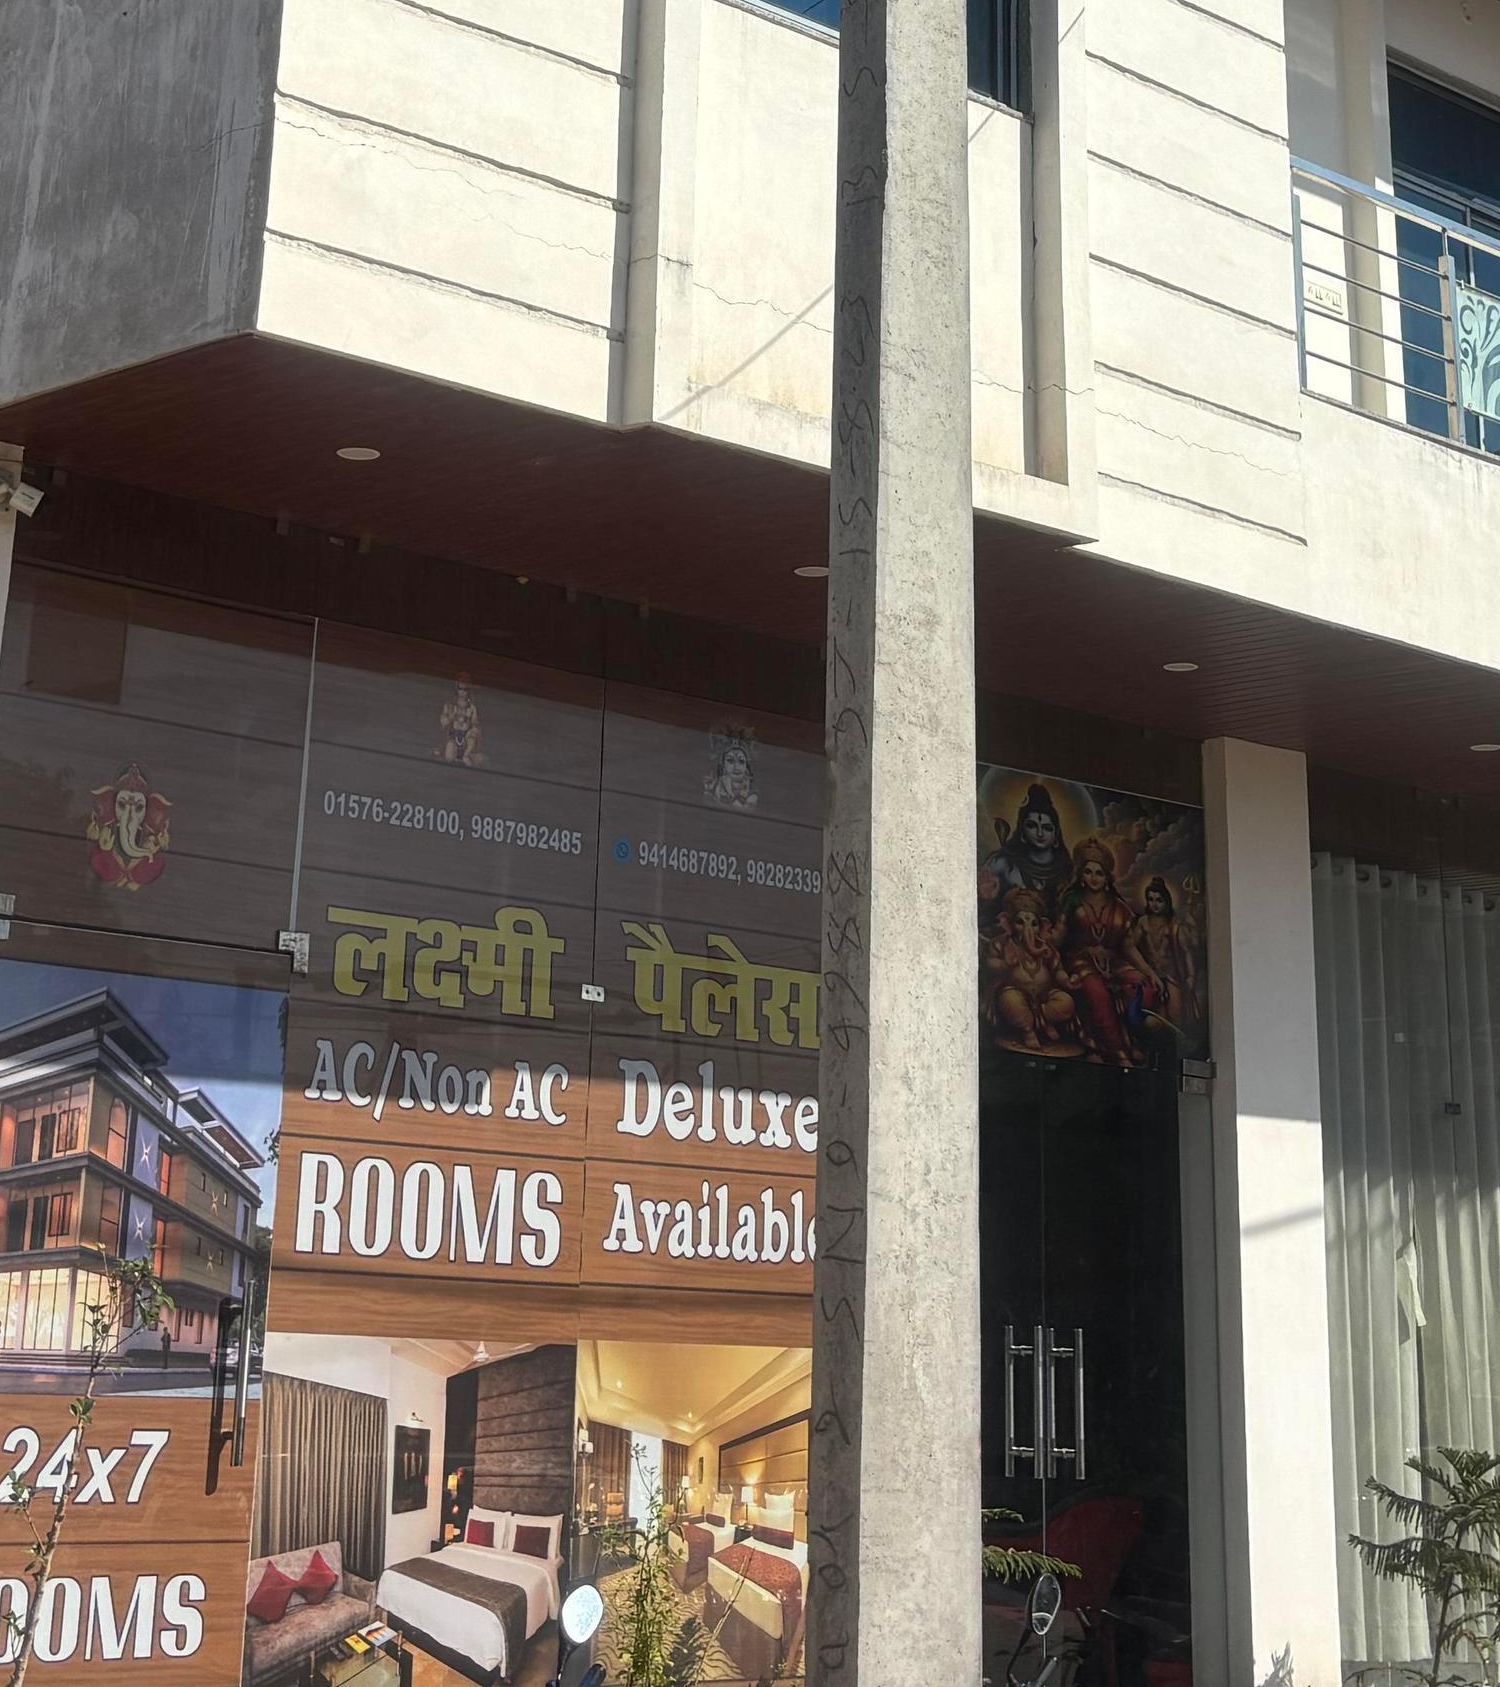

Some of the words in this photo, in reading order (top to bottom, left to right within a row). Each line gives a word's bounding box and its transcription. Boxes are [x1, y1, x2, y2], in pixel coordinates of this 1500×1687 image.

[323, 790, 464, 841] 01576-228100,
[471, 815, 582, 855] 9887982485
[638, 840, 741, 885] 9414687892,
[326, 906, 565, 1020] लक्ष्मी
[304, 1038, 493, 1122] AC/Non
[504, 1061, 569, 1126] AC
[616, 1058, 818, 1152] Deluxe
[294, 1151, 563, 1268] ROOMS
